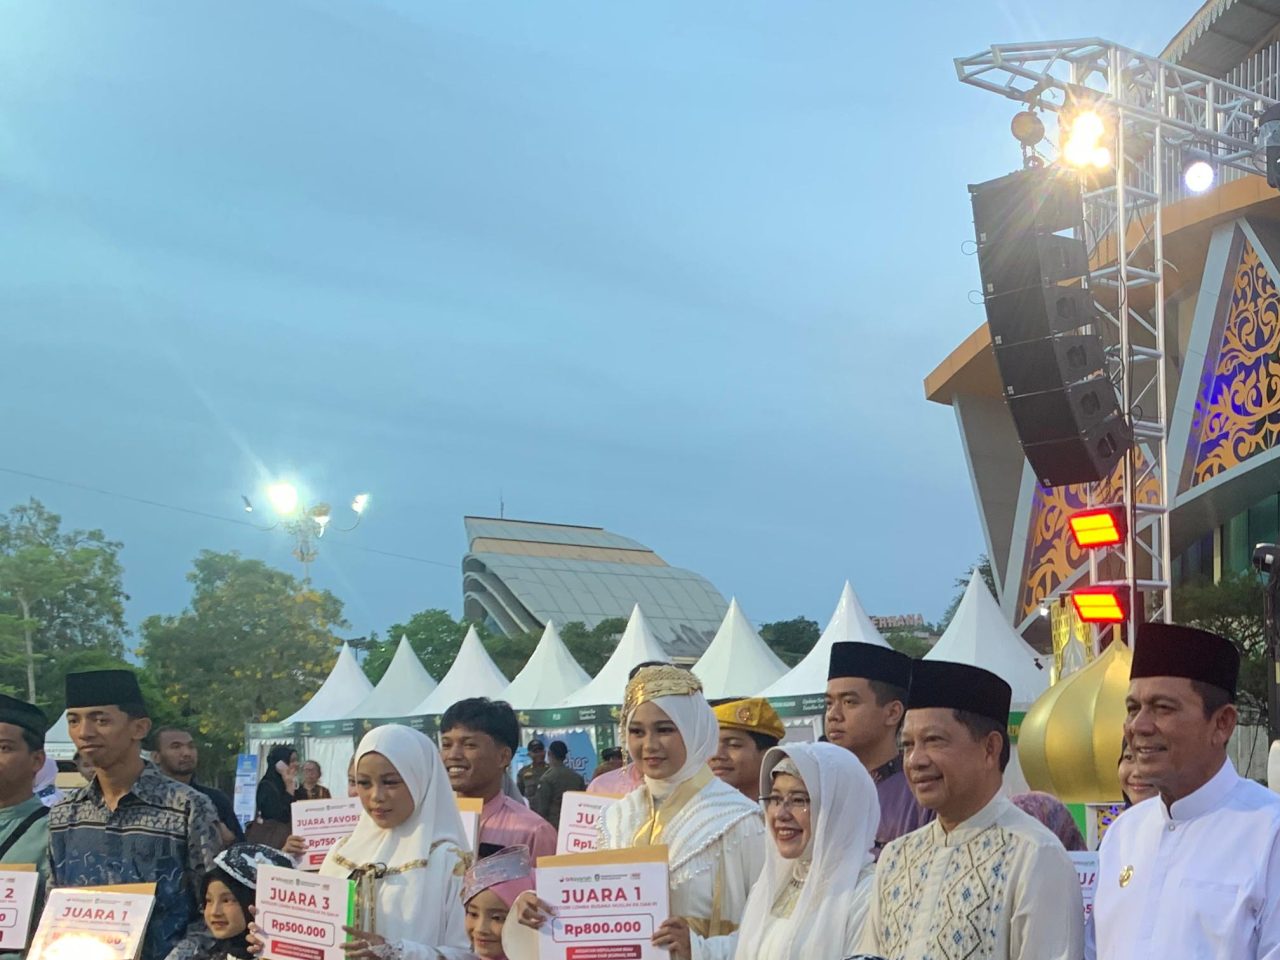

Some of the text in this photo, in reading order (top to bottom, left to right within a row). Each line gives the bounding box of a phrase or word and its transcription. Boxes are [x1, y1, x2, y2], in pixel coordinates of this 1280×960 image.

[270, 887, 317, 907] JUARA
[322, 896, 330, 911] 3
[561, 886, 641, 904] JUARA 1
[62, 906, 129, 921] JUARA 1
[271, 919, 326, 939] Rp500.000
[564, 921, 642, 938] Rp800.000
